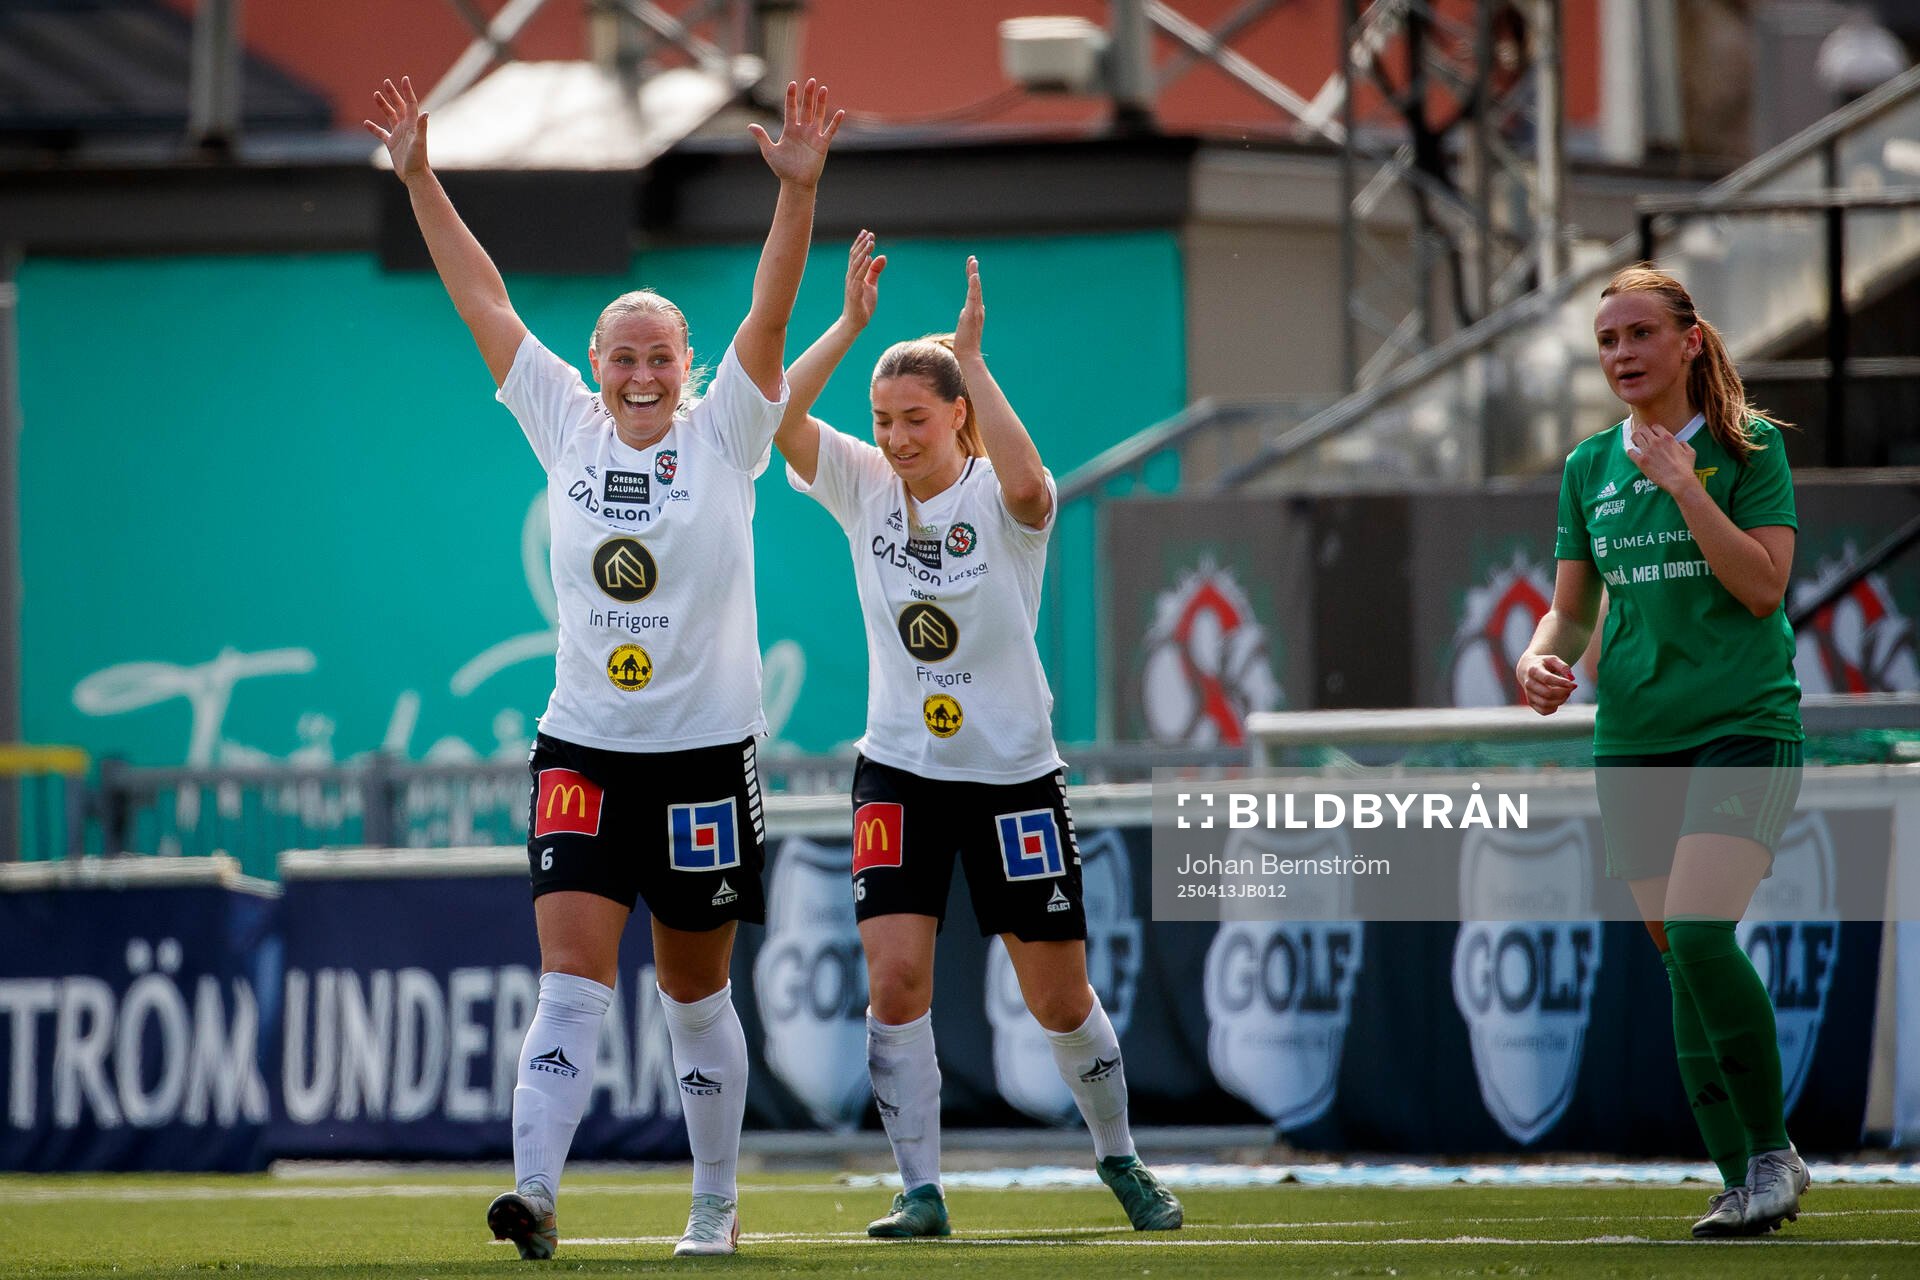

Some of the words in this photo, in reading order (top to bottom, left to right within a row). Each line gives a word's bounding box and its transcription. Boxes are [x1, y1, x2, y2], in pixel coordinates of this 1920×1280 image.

[607, 484, 648, 494] SALUHALL
[612, 474, 644, 485] ÖREBRO
[1612, 531, 1656, 550] UMEÅ
[1658, 529, 1697, 544] ENER
[1632, 564, 1660, 584] MER
[589, 609, 604, 627] In
[607, 610, 670, 635] Frigore
[916, 665, 972, 688] Frigore
[540, 847, 554, 871] 6
[711, 894, 738, 906] SELECT
[853, 878, 867, 903] 16
[1047, 902, 1071, 913] SELECT
[1218, 928, 1352, 1014] GOLF
[1466, 928, 1592, 1015] GOLF
[529, 1063, 577, 1079] SELECT
